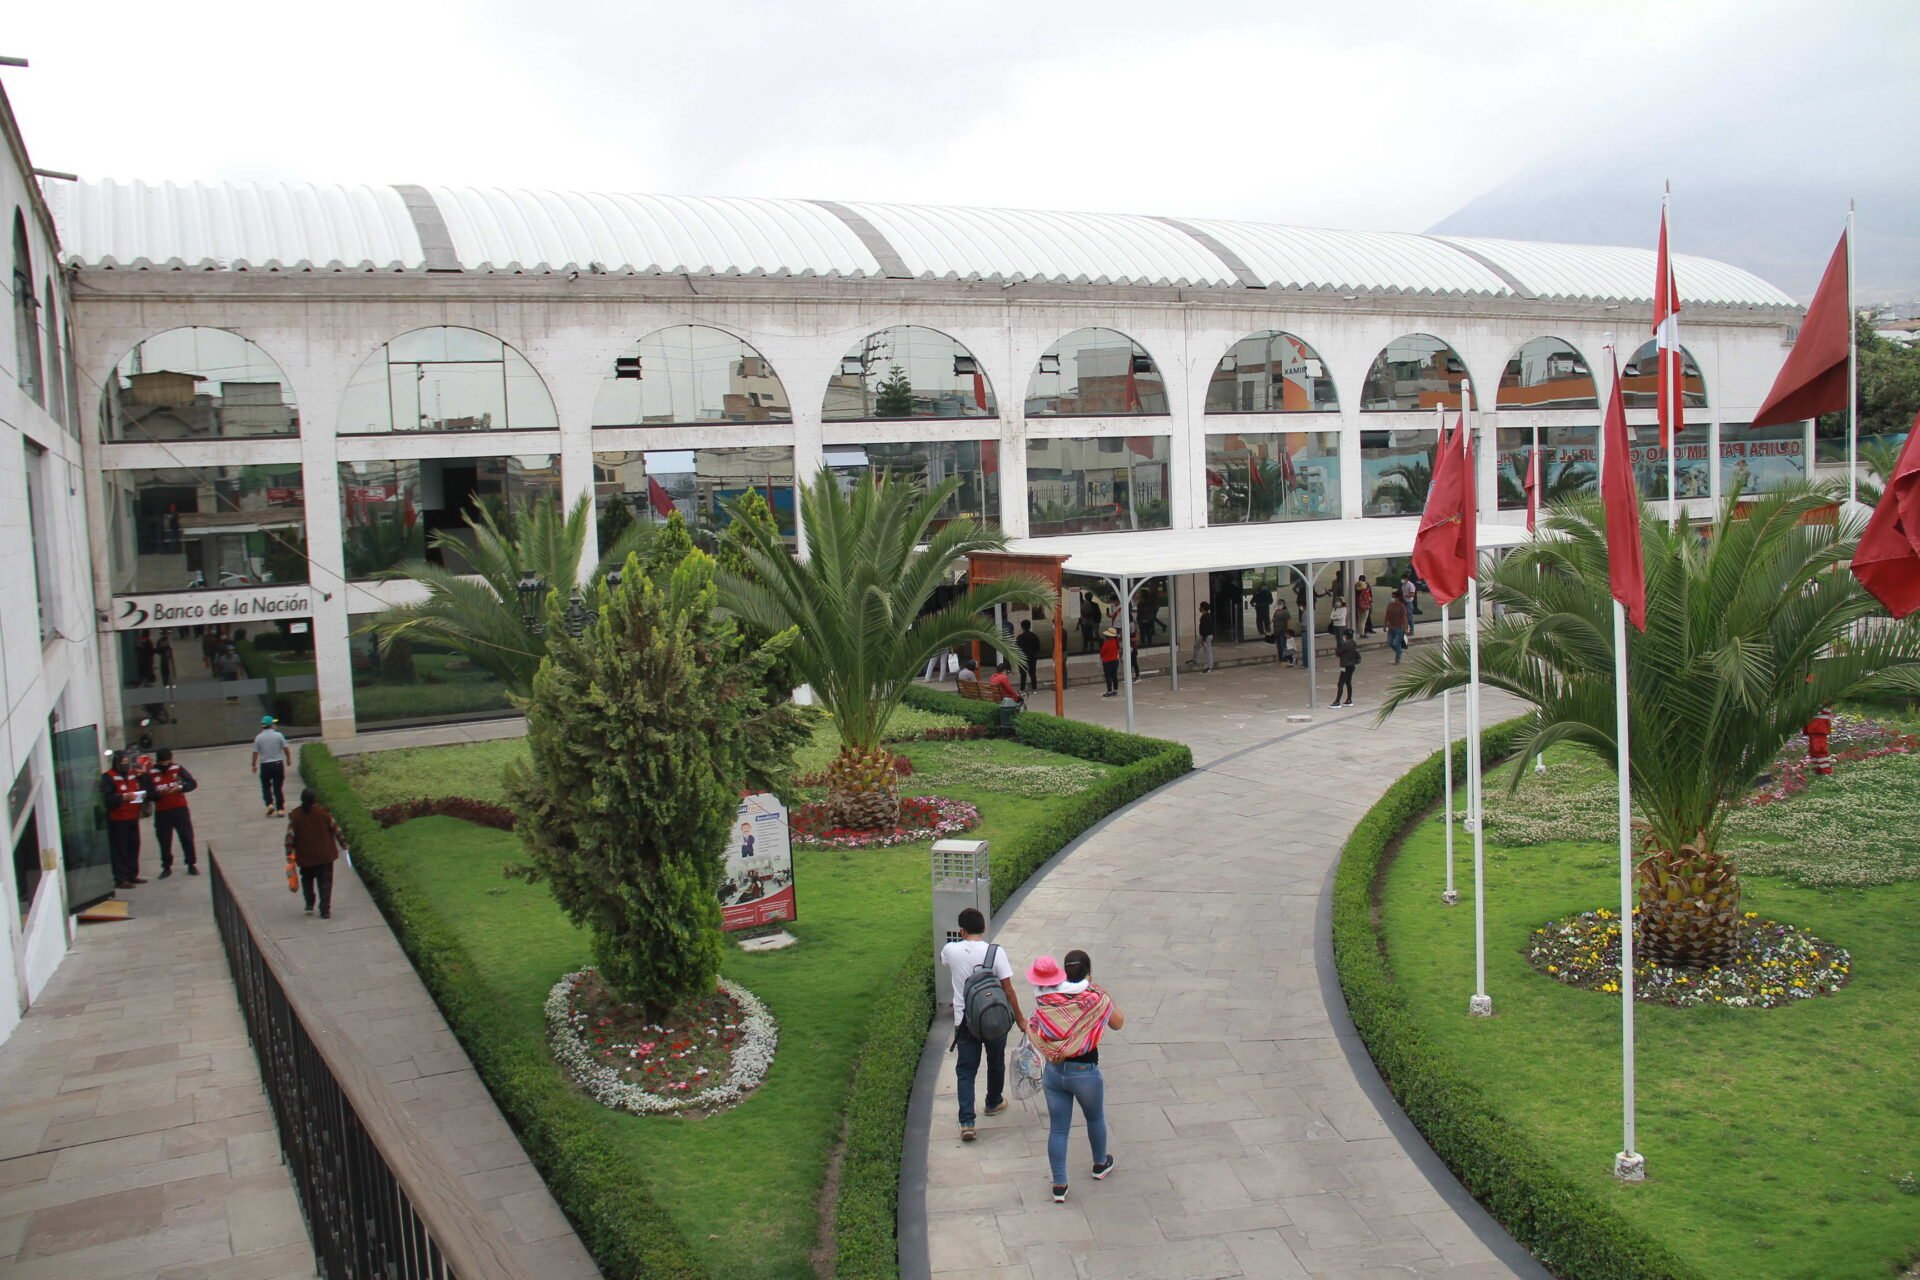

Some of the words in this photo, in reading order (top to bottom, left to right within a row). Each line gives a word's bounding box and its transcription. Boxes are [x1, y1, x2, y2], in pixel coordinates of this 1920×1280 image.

[154, 603, 204, 620] Banco
[210, 600, 228, 616] de
[234, 598, 249, 614] la
[253, 593, 308, 613] Nación
